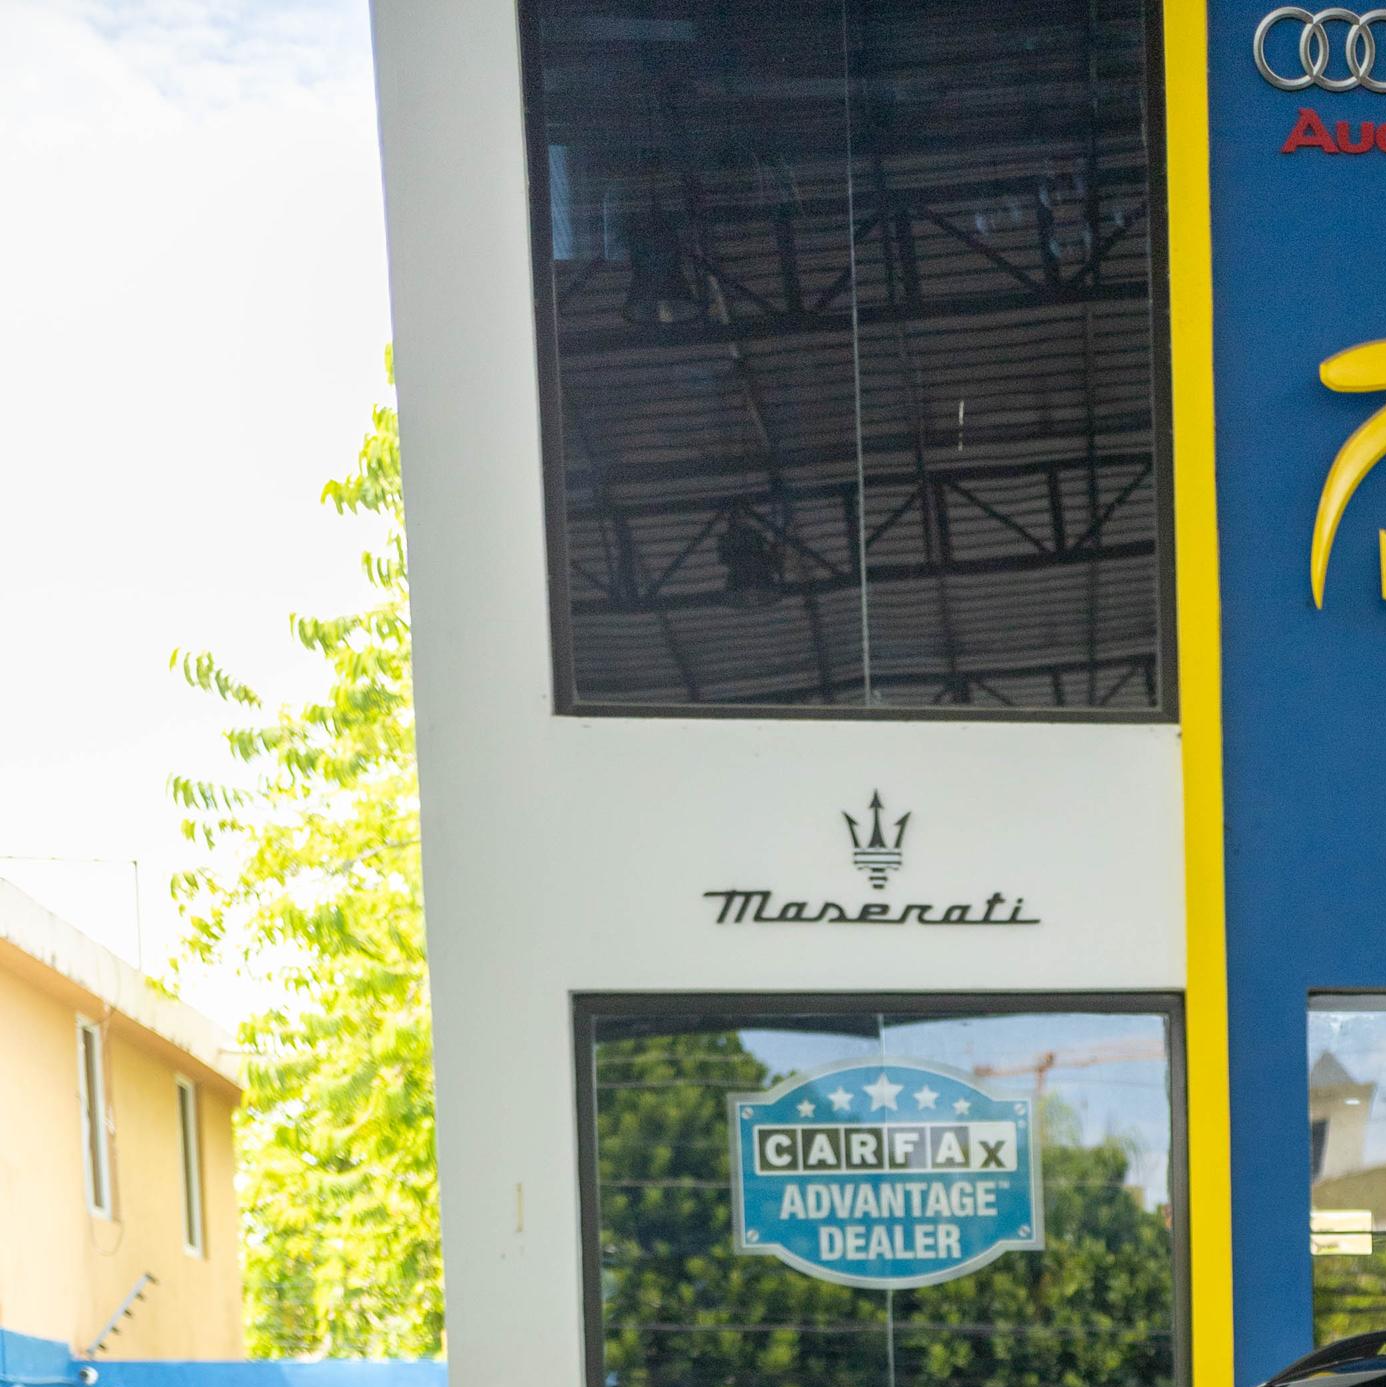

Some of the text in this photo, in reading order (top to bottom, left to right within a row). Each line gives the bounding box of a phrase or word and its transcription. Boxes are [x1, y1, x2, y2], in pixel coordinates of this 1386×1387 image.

[703, 890, 1041, 925] Maserati
[762, 1130, 1007, 1169] CARFAX
[780, 1181, 998, 1220] ADVANTAGE
[818, 1224, 961, 1261] DEALER
